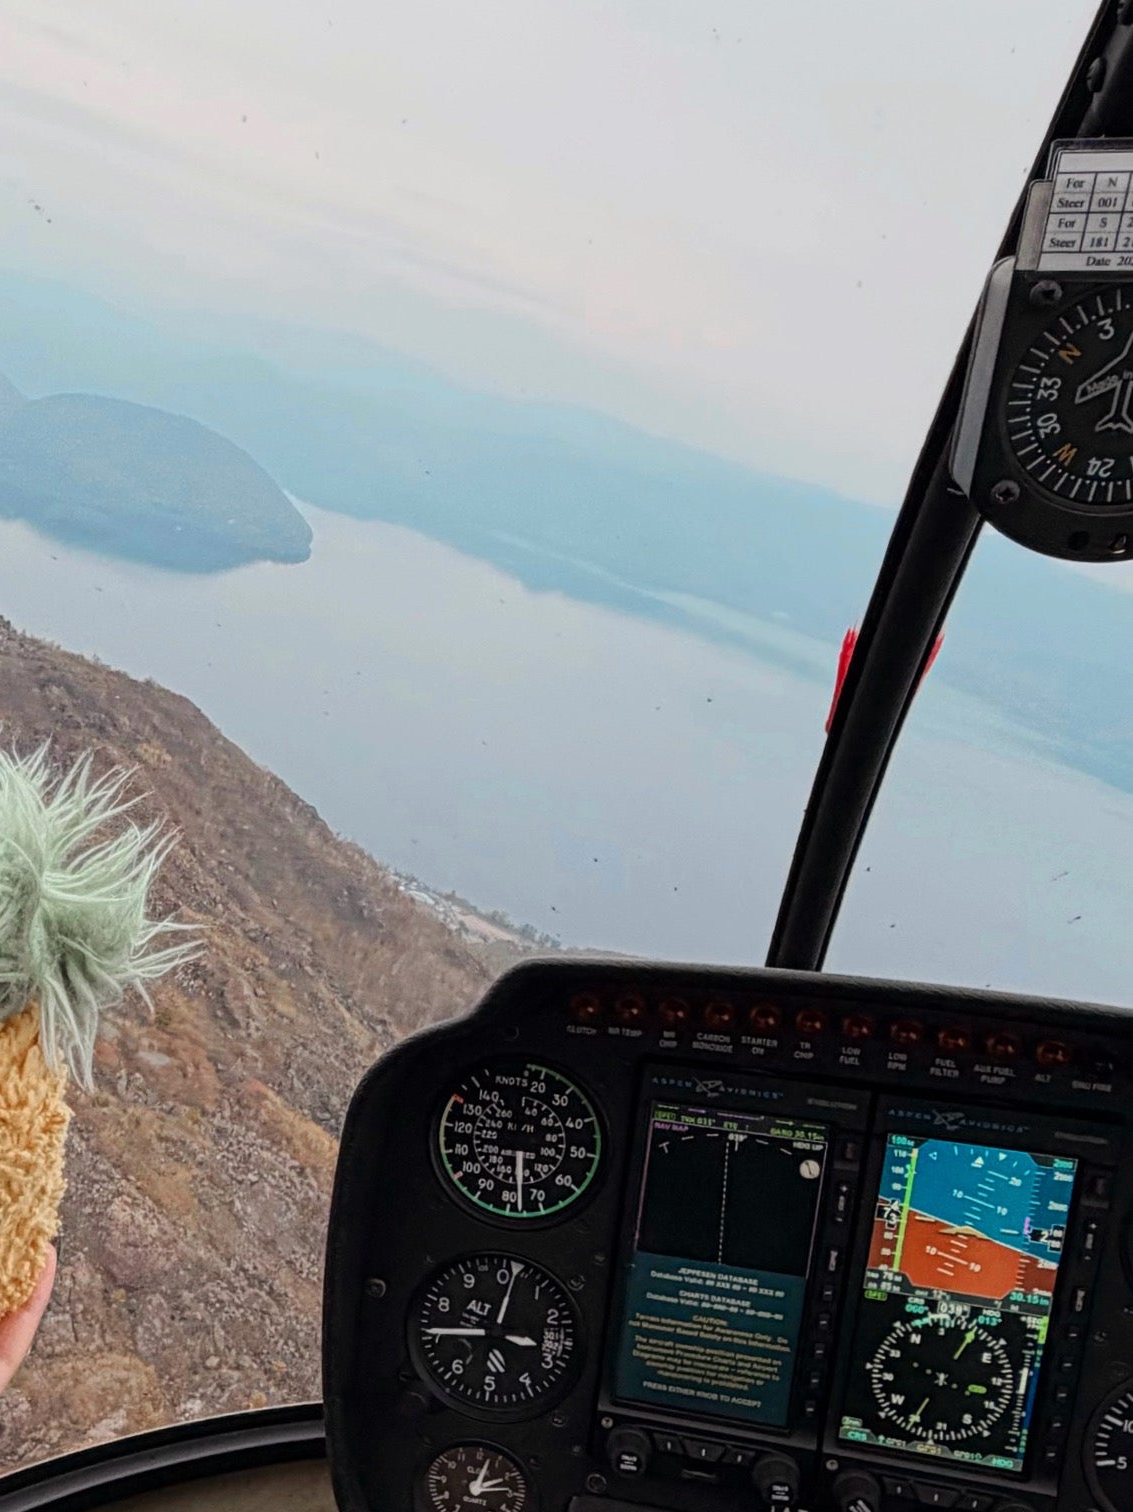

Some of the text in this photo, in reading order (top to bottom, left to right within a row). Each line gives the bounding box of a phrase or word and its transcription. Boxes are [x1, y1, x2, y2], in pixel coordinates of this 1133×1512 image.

[1066, 177, 1118, 188] For N
[1056, 197, 1117, 208] Steer 001
[1057, 217, 1108, 228] For S
[1049, 238, 1076, 248] Steer
[1086, 256, 1111, 266] Date
[1097, 318, 1115, 341] 3
[1058, 342, 1082, 365] N
[1036, 377, 1062, 401] 33
[1036, 412, 1061, 439] 30
[1086, 457, 1115, 478] 24
[566, 1024, 598, 1036] CLUTCH
[622, 1027, 642, 1038] TEMP
[696, 1031, 731, 1044] CARBON
[741, 1035, 778, 1049] STARTER
[793, 1050, 815, 1060] CHIP
[841, 1046, 862, 1056] LOW
[887, 1051, 908, 1062] LOW
[839, 1055, 861, 1066] FUEL
[887, 1061, 907, 1072] RPM
[935, 1057, 956, 1069] FUEL
[929, 1066, 960, 1078] FILTER
[973, 1063, 991, 1074] AUX
[495, 1075, 528, 1087] KNOTS
[980, 1074, 1006, 1085] PUMP
[529, 1081, 546, 1094] 20
[652, 1076, 778, 1099] ASPEN AVIONICS
[478, 1090, 500, 1102] 140
[551, 1094, 569, 1107] 30
[462, 1103, 483, 1116] 130
[887, 1108, 932, 1120] ASPEN
[453, 1121, 473, 1134] 120
[566, 1117, 583, 1129] 40
[569, 1147, 586, 1159] 50
[462, 1161, 481, 1175] 100
[477, 1178, 495, 1191] 90
[555, 1174, 572, 1187] 60
[501, 1190, 517, 1203] 80
[529, 1188, 546, 1201] 70
[463, 1273, 475, 1288] 9
[496, 1268, 510, 1285] 0
[718, 1273, 759, 1286] DATABASE
[438, 1297, 450, 1312] 8
[678, 1289, 709, 1302] CHARTS
[710, 1294, 751, 1308] DATABASE
[466, 1299, 492, 1316] ALT
[908, 1296, 1001, 1318] CRS HDG
[546, 1308, 559, 1325] 2
[451, 1359, 464, 1374] 6
[541, 1353, 554, 1369] 3
[483, 1375, 496, 1391] 5
[519, 1372, 531, 1386] 4
[847, 1430, 1014, 1468] CRS HDG
[1116, 1456, 1128, 1470] 5
